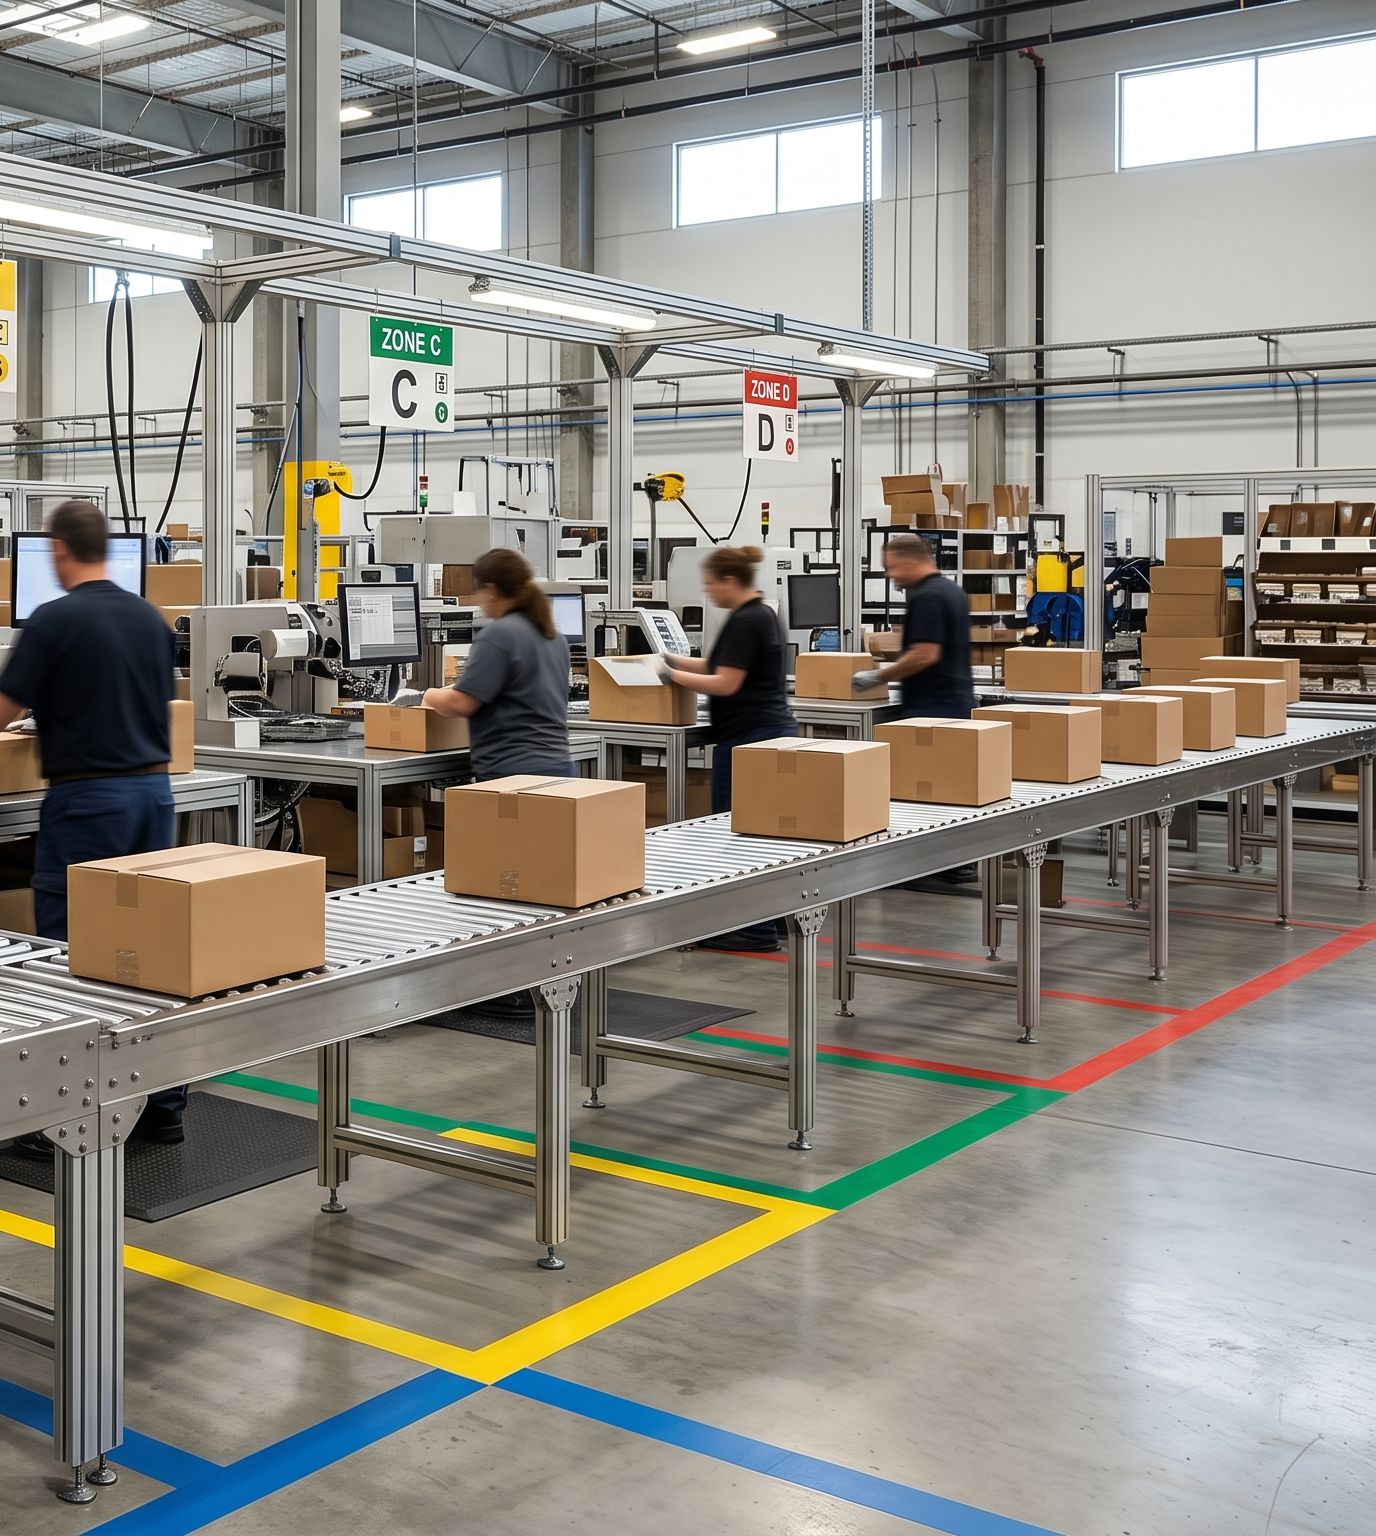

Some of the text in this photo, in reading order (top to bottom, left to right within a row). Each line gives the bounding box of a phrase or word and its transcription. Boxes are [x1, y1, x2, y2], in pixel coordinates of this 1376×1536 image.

[381, 327, 441, 356] ZONE C
[391, 369, 418, 419] C
[751, 379, 781, 401] ZONE
[758, 413, 775, 451] D
